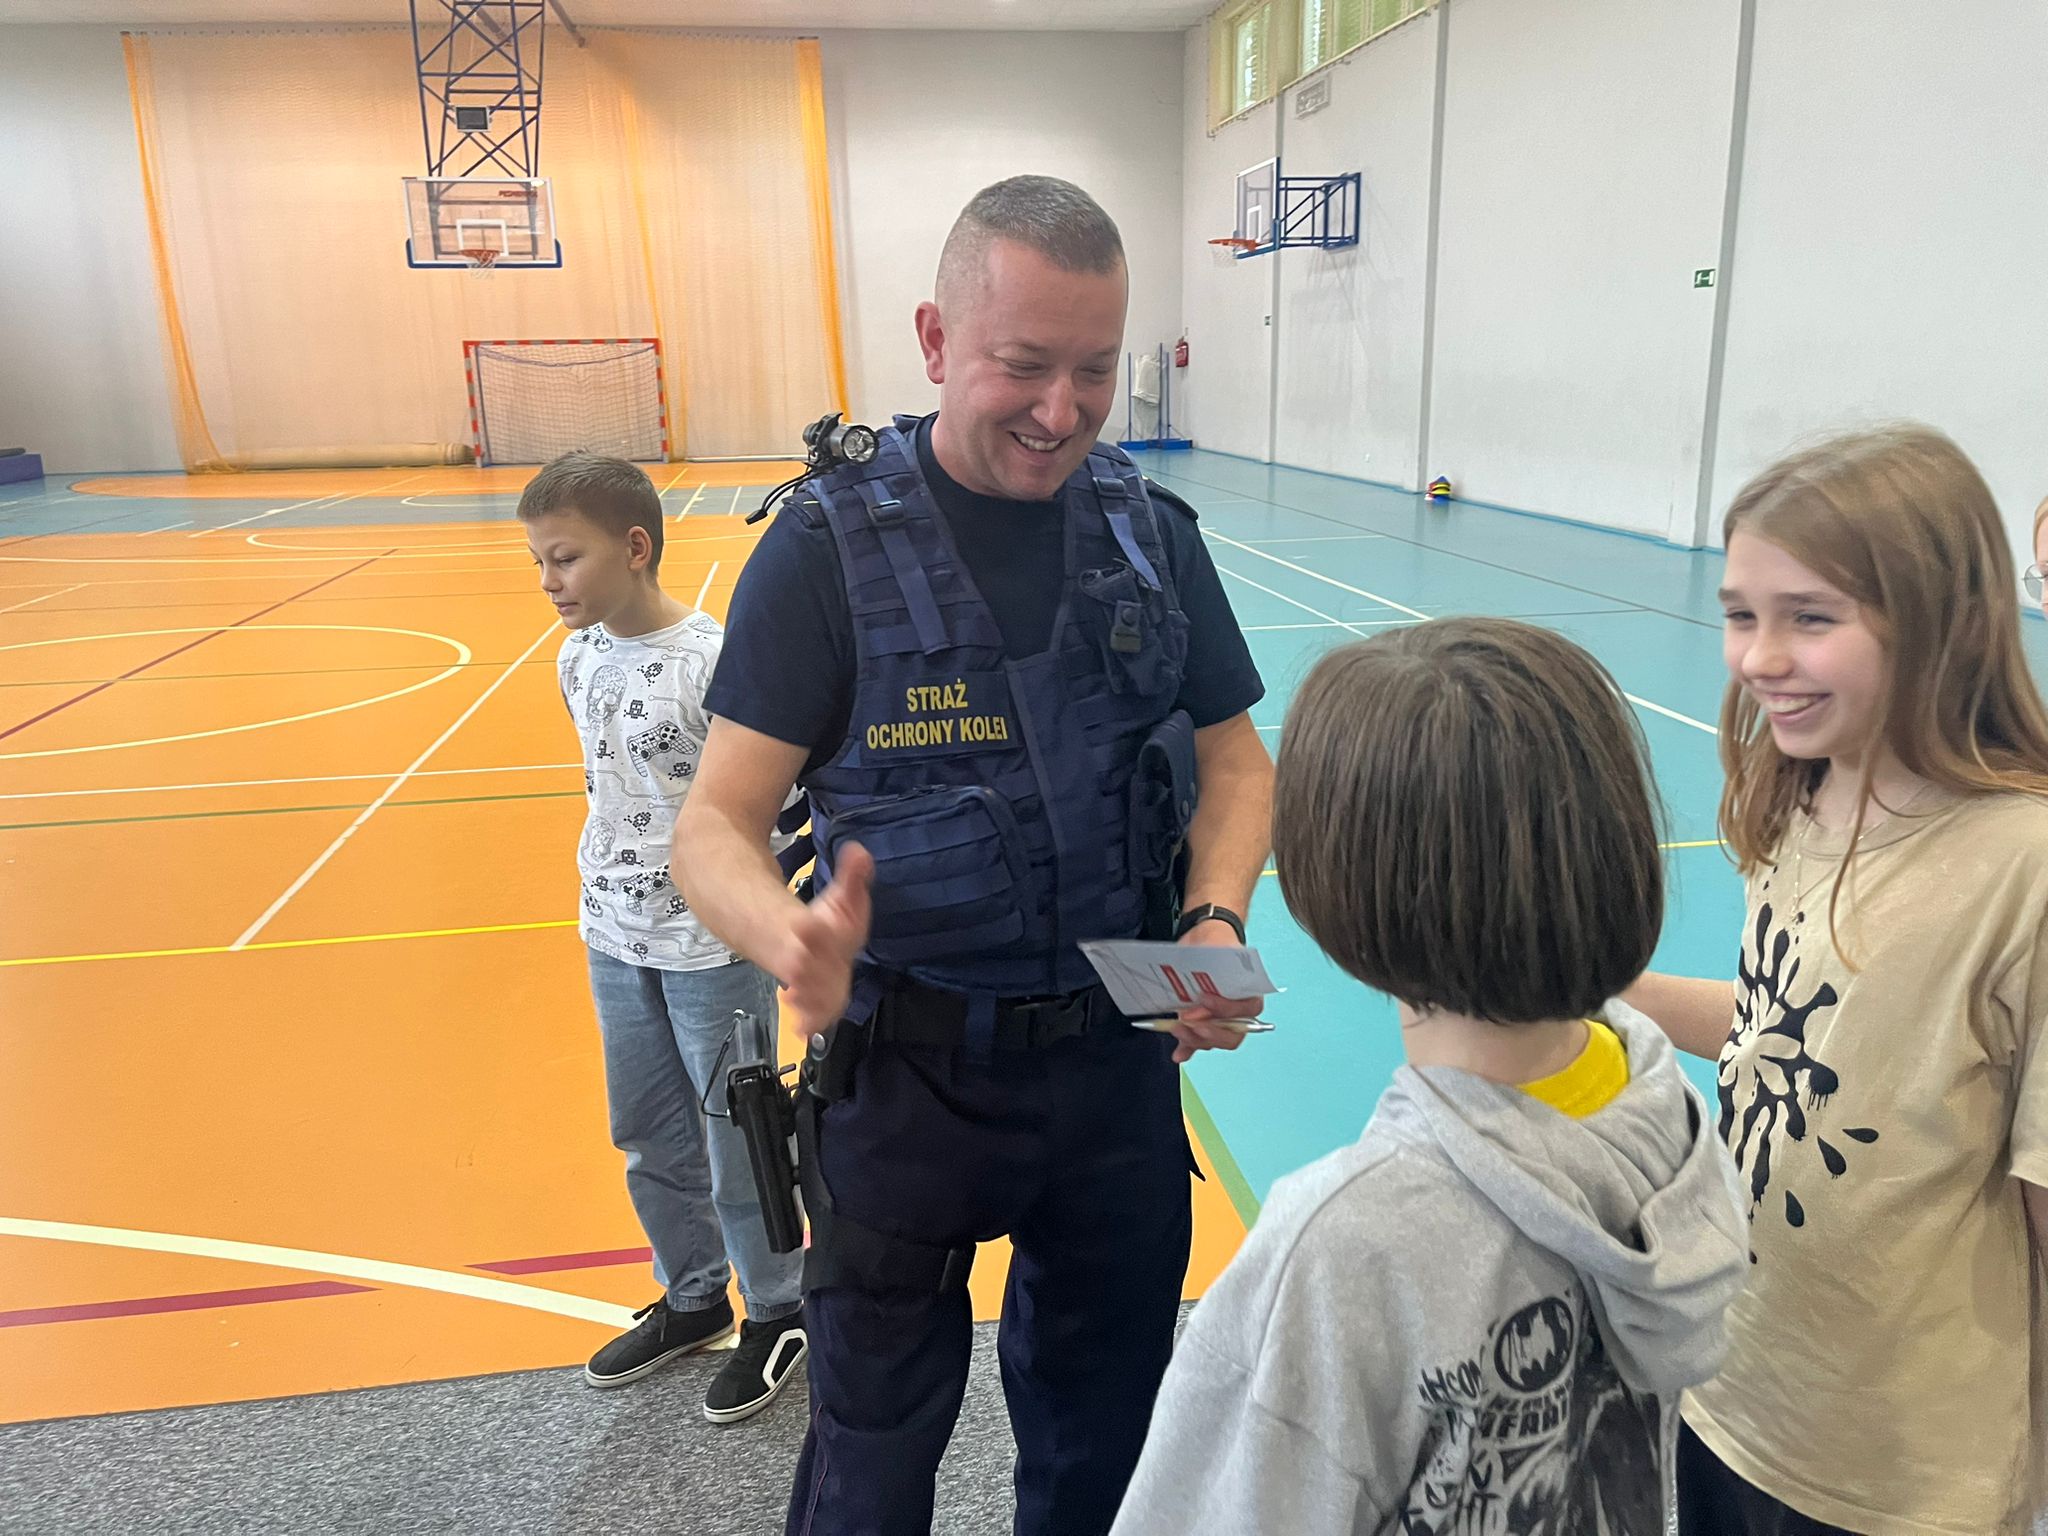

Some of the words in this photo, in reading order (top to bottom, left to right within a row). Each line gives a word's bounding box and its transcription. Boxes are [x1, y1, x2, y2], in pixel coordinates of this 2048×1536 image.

[906, 678, 968, 712] STRAŻ
[867, 719, 954, 750] OCHRONY
[960, 715, 1008, 742] KOLEI
